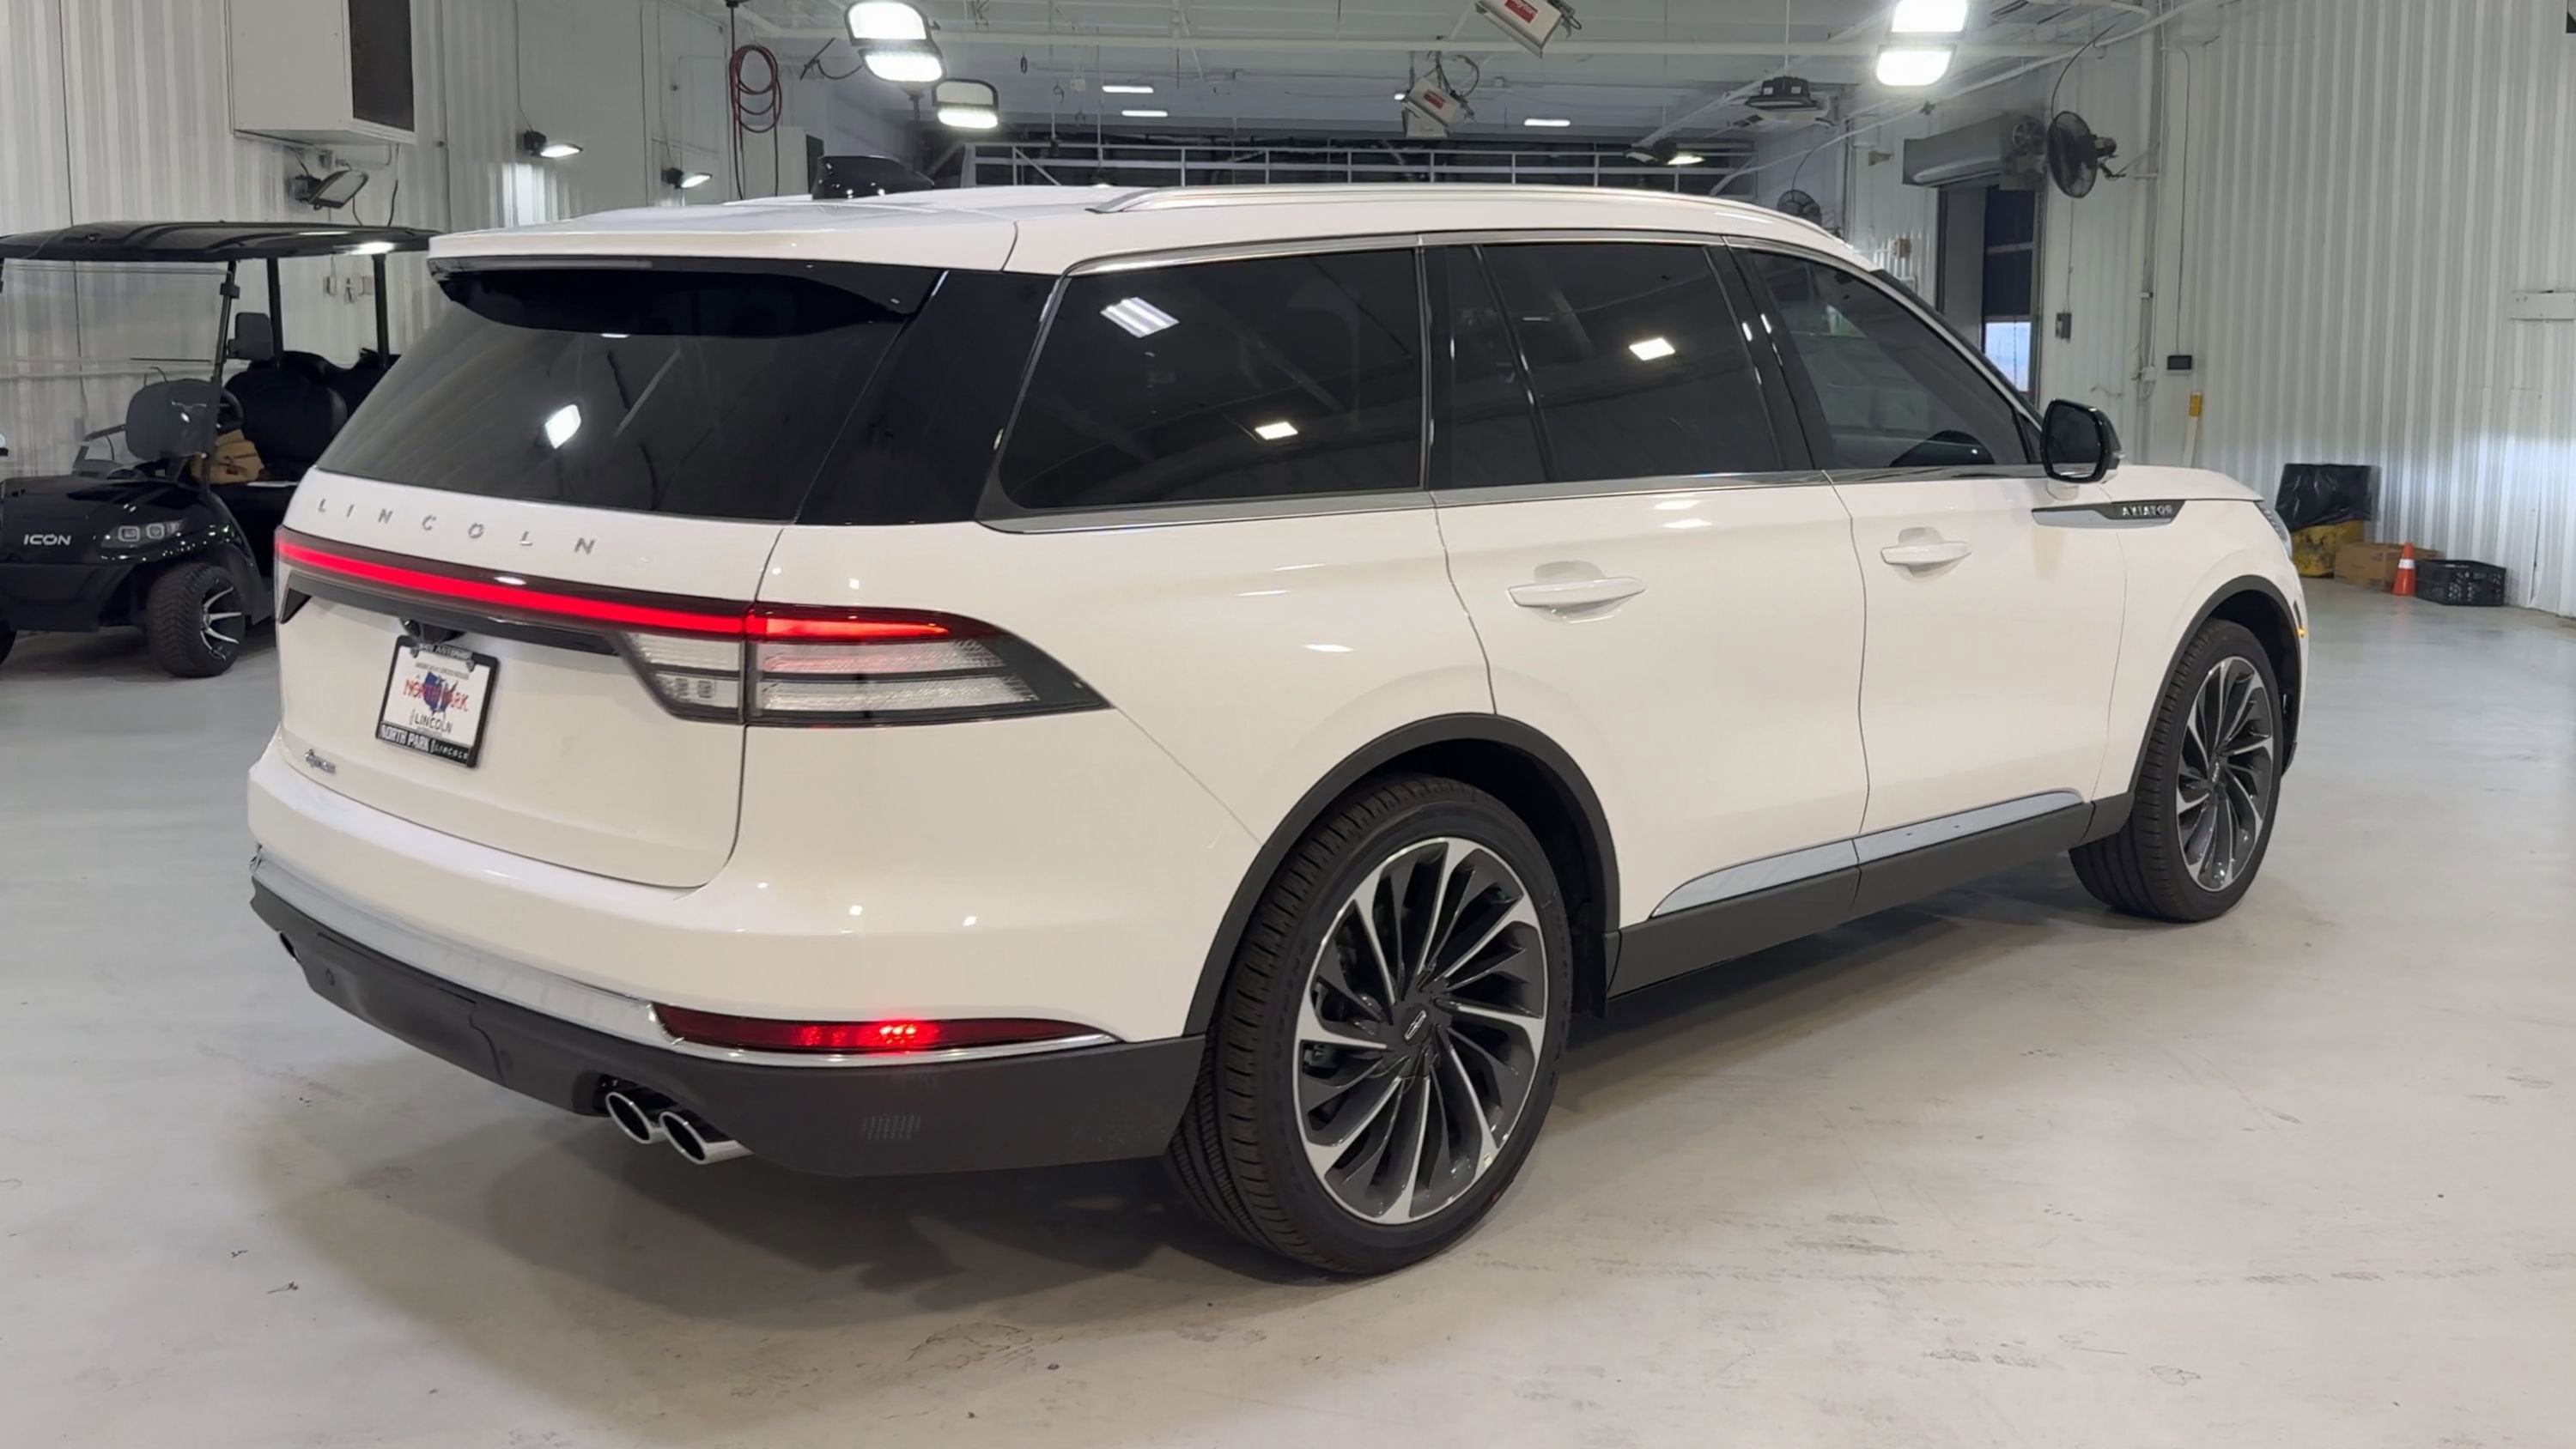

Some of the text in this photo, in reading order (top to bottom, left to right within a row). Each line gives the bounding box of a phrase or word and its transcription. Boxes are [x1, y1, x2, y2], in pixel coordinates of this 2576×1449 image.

[2122, 505, 2173, 517] AVIATOR
[318, 499, 595, 555] LINCOLN
[23, 534, 72, 546] ICON
[414, 712, 453, 734] LINCOLN
[380, 724, 407, 744] NORTH
[407, 732, 430, 753] PARK
